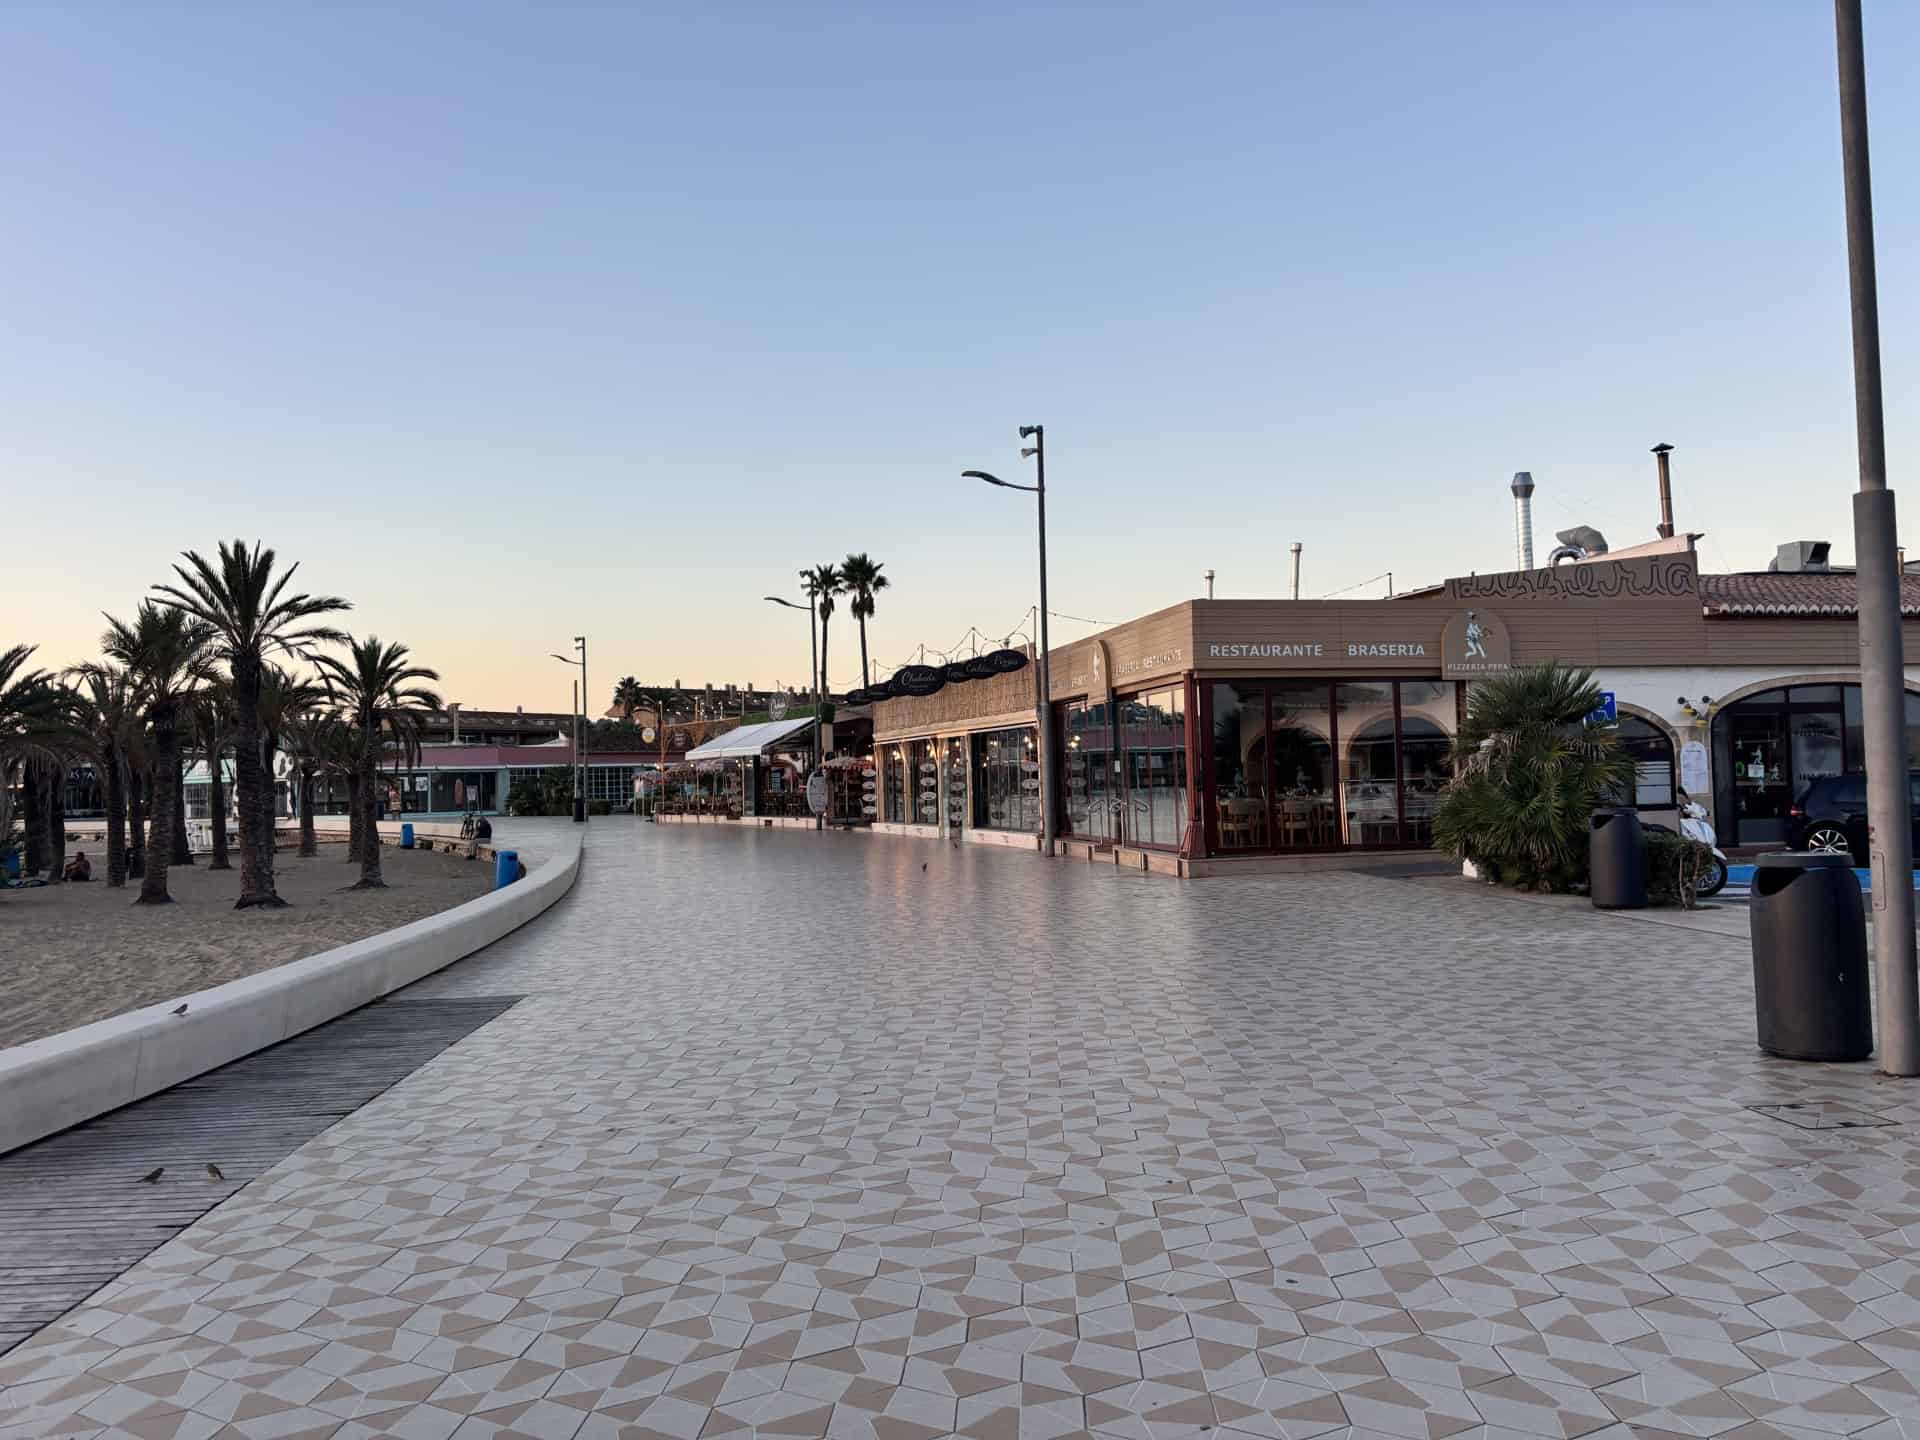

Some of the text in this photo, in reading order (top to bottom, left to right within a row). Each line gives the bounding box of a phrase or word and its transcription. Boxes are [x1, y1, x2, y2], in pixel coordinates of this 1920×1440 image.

[1209, 643, 1426, 658] RESTAURANTE BRASERIA
[1447, 663, 1487, 673] PIZZERIA
